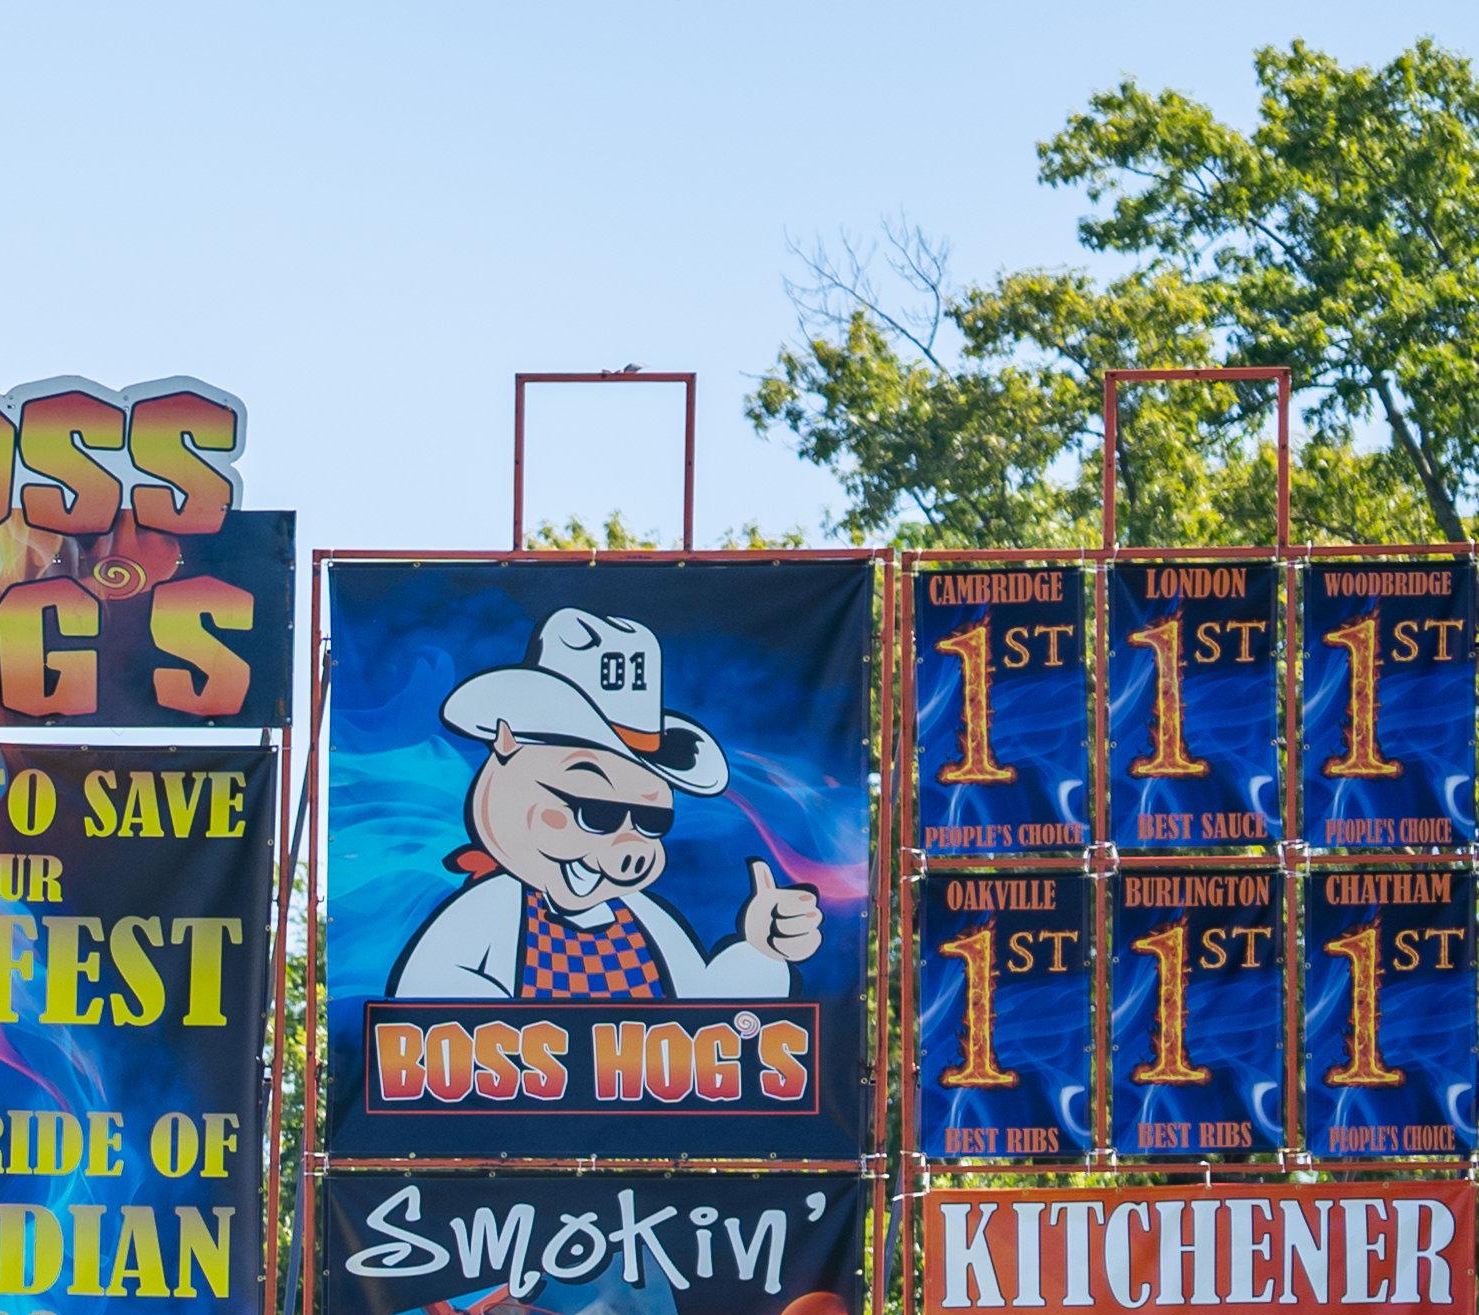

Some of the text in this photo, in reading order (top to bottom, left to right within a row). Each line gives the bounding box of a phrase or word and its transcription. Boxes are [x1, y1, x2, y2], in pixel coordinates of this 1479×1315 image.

[1146, 568, 1246, 598] LONDON
[83, 769, 247, 838] SAVE
[1137, 813, 1267, 840] BEST SAUCE
[150, 1112, 239, 1179] OF
[941, 1199, 1453, 1309] KITCHENER
